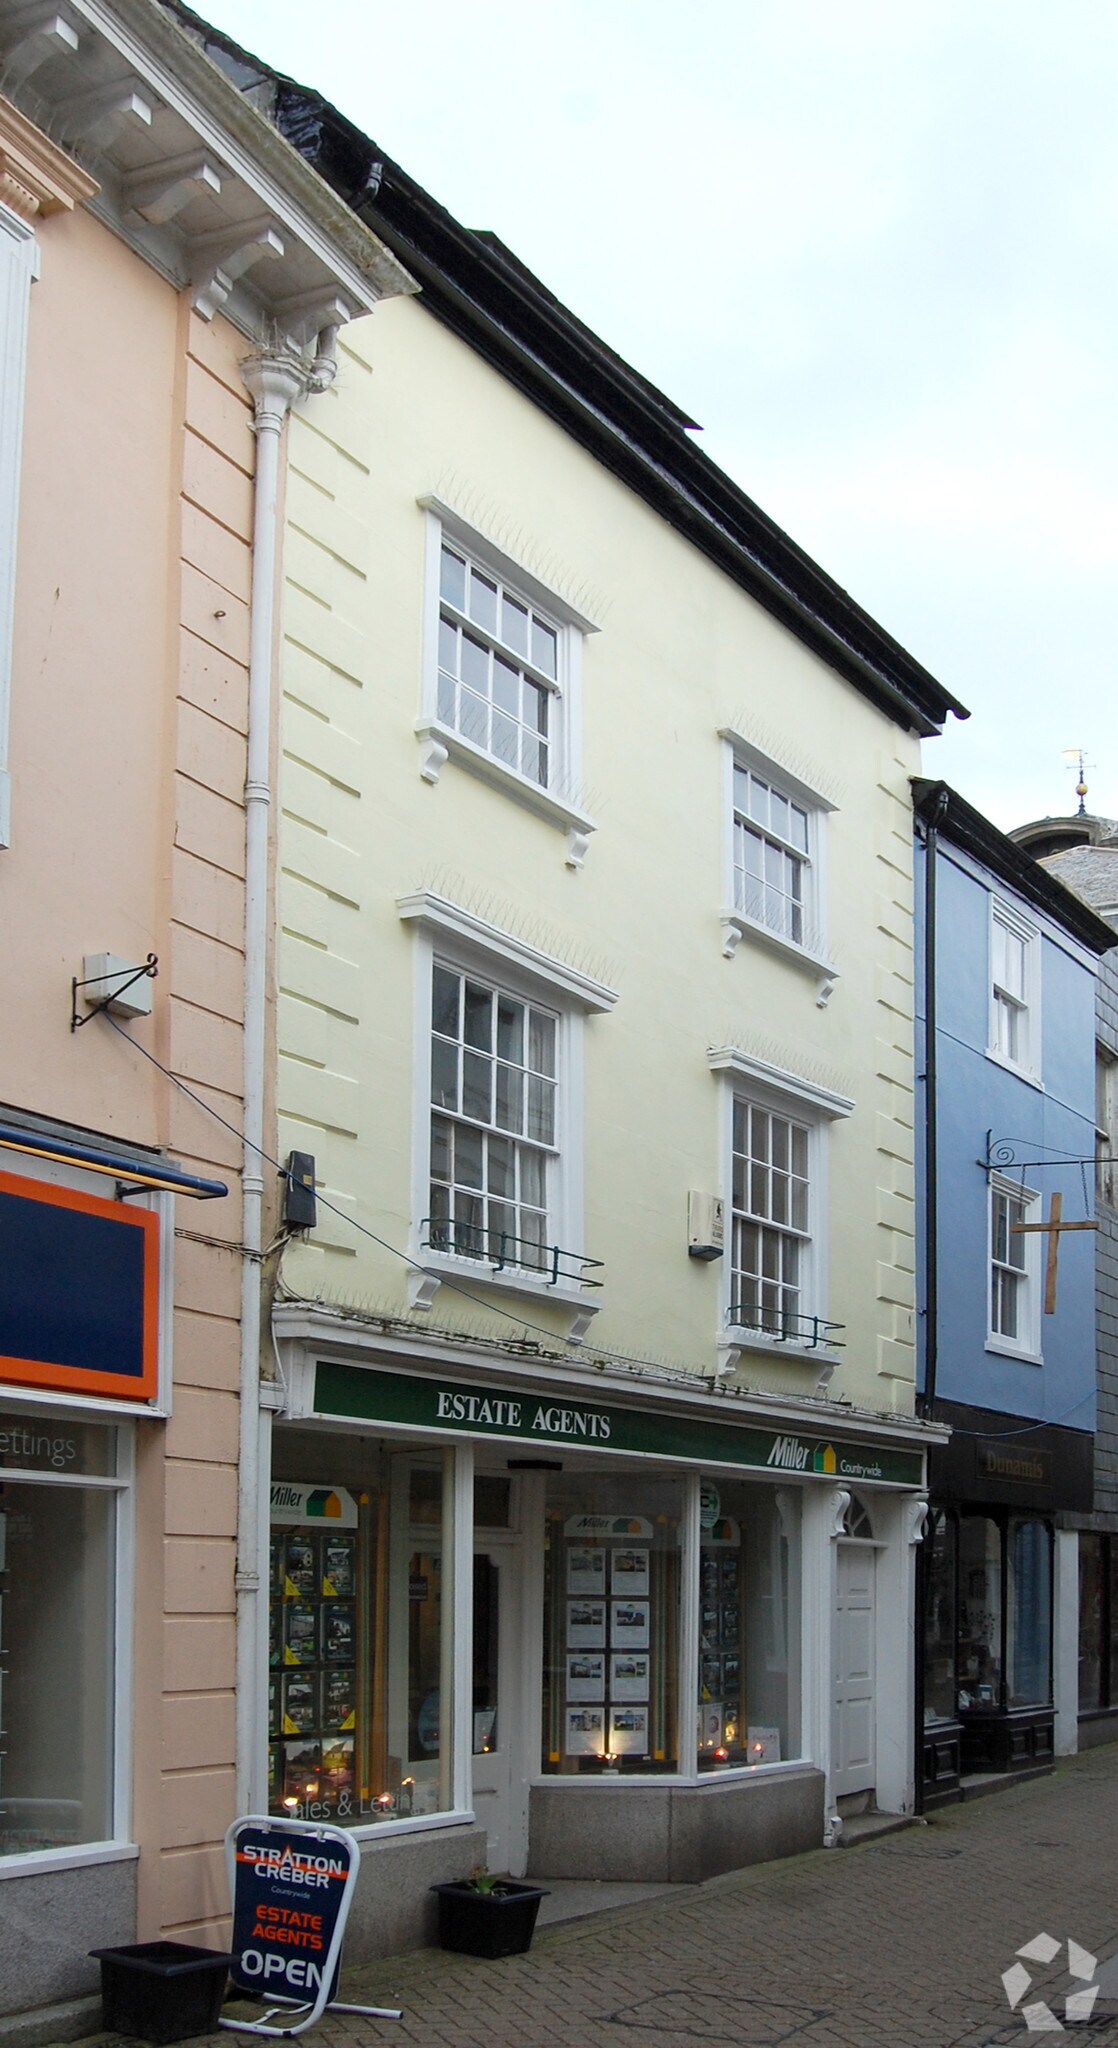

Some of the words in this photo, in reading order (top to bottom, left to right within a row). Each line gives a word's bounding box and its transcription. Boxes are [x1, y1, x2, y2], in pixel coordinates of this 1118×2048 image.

[436, 1391, 522, 1427] ESTATE
[531, 1406, 612, 1439] AGENTS
[0, 1428, 76, 1467] ettings
[766, 1436, 810, 1469] Miller
[840, 1459, 882, 1478] Countrywide
[986, 1450, 1044, 1479] Dunamis
[271, 1486, 303, 1507] Miller
[337, 1791, 353, 1817] &
[243, 1845, 342, 1875] STRATTON
[254, 1863, 330, 1888] CREBER
[271, 1885, 311, 1900] Countrywide
[255, 1904, 323, 1930] ESTATE
[252, 1923, 323, 1950] AGENTS
[240, 1949, 326, 1990] OPEN
